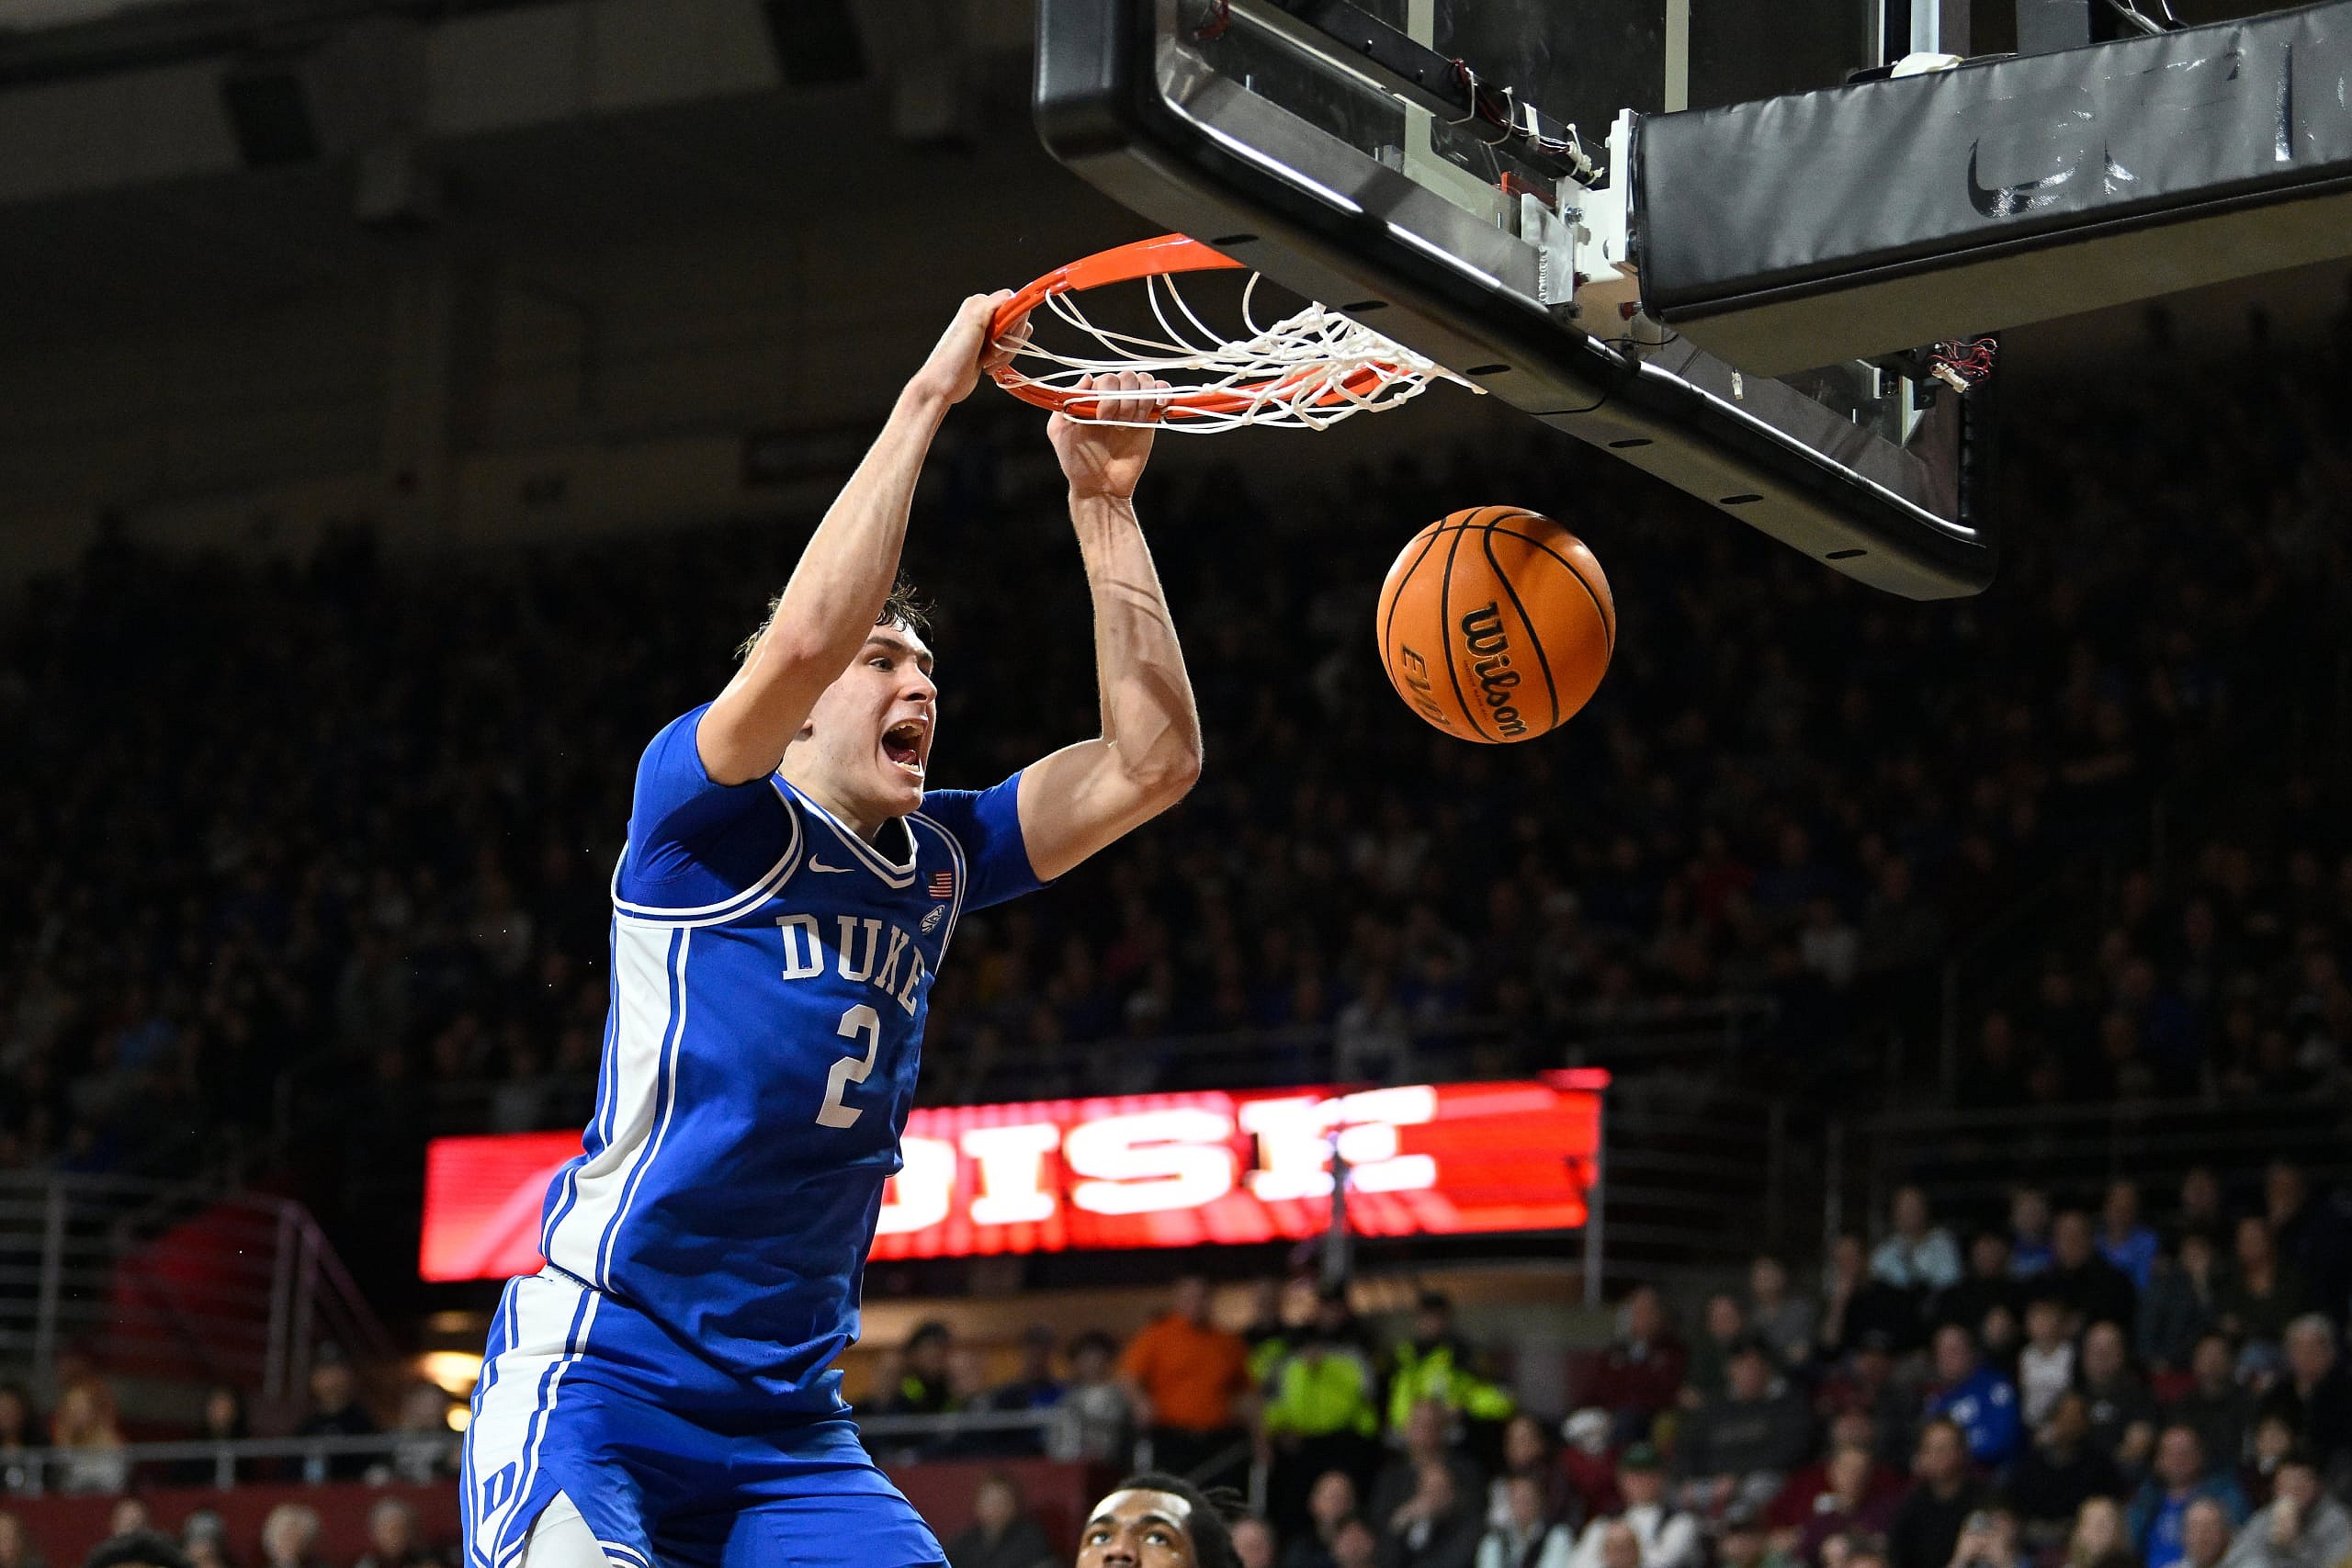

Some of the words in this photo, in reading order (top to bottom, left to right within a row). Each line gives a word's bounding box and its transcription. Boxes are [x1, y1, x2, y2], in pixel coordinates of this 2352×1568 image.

[1460, 601, 1529, 738] Wilson
[775, 913, 925, 1017] DUKE
[816, 1003, 881, 1129] 2
